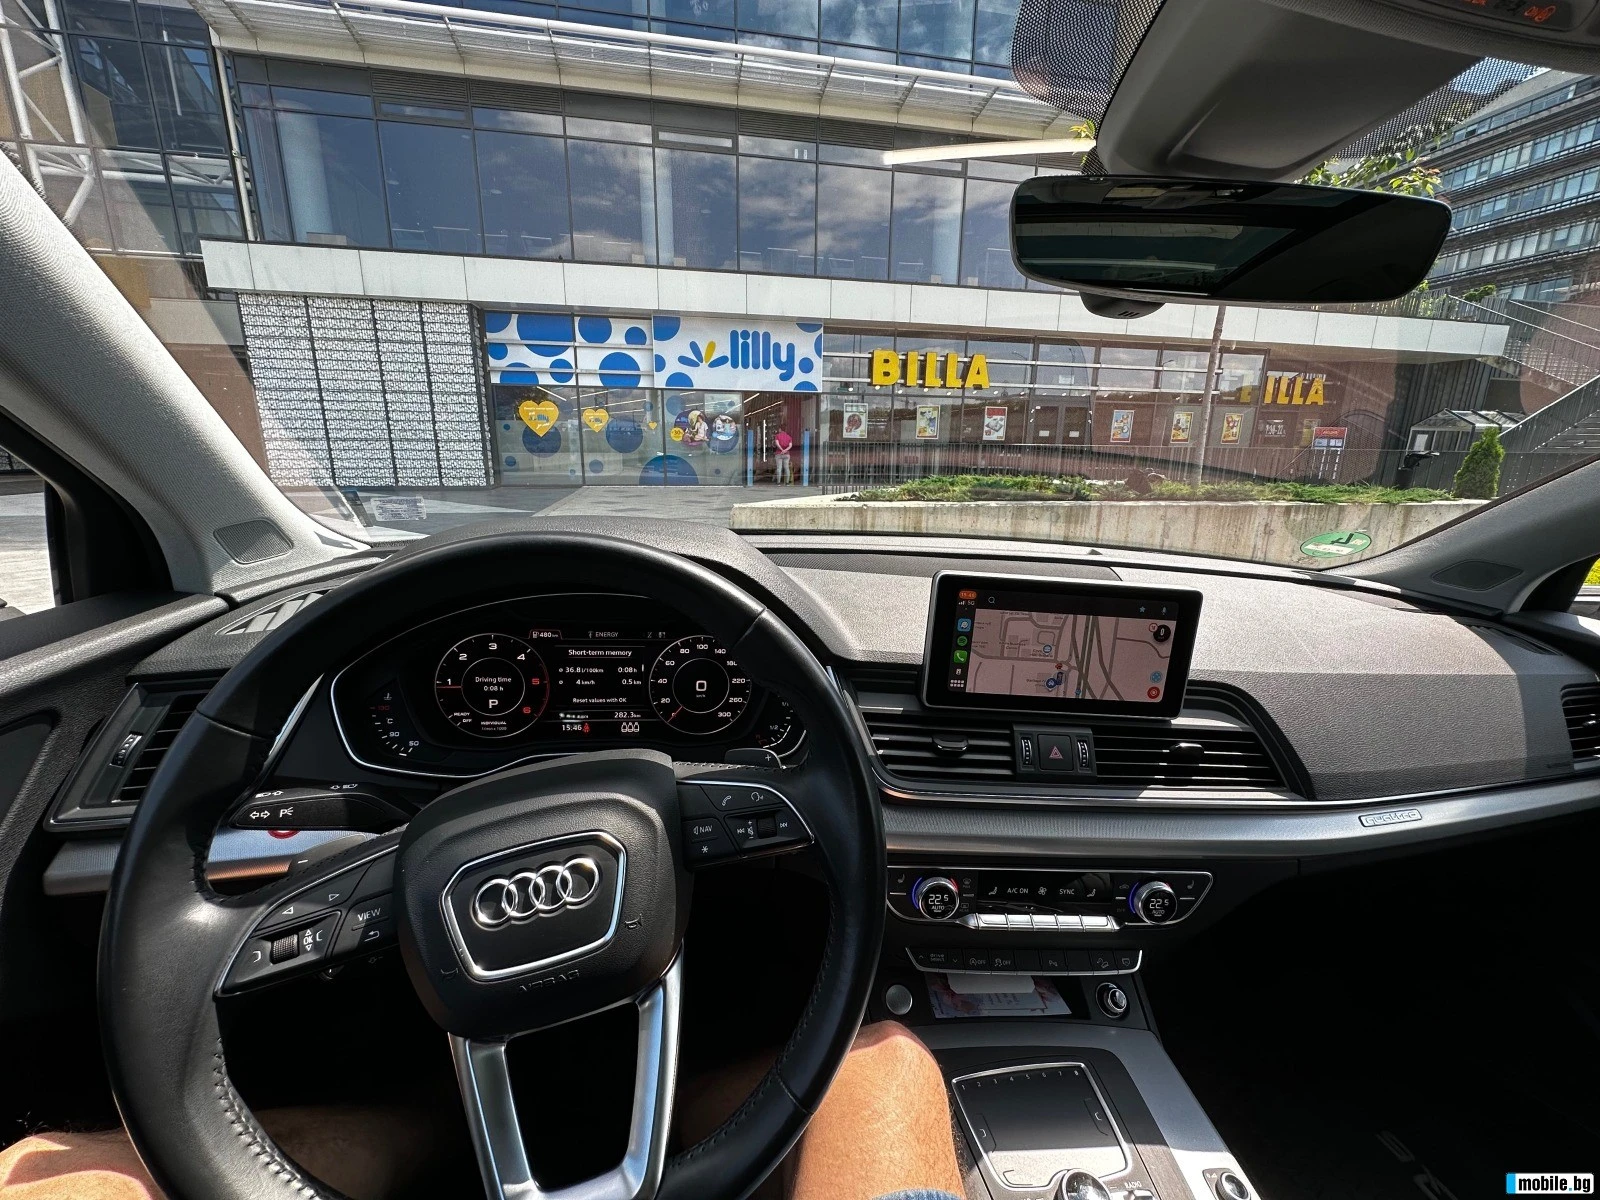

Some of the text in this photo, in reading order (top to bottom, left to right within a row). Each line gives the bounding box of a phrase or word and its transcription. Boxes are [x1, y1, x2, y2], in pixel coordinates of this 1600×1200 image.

[729, 329, 796, 382] lilly
[872, 349, 990, 389] BILLA
[516, 653, 526, 661] 4
[447, 678, 452, 686] 1
[475, 676, 497, 684] Driving
[695, 680, 707, 691] 0
[488, 699, 499, 709] P
[522, 706, 531, 714] 6
[614, 711, 634, 719] 282.3
[1365, 812, 1419, 825] quattro
[699, 825, 713, 834] NAV
[357, 907, 381, 922] VIEW
[303, 936, 313, 945] OK
[1124, 1180, 1142, 1189] RADIO
